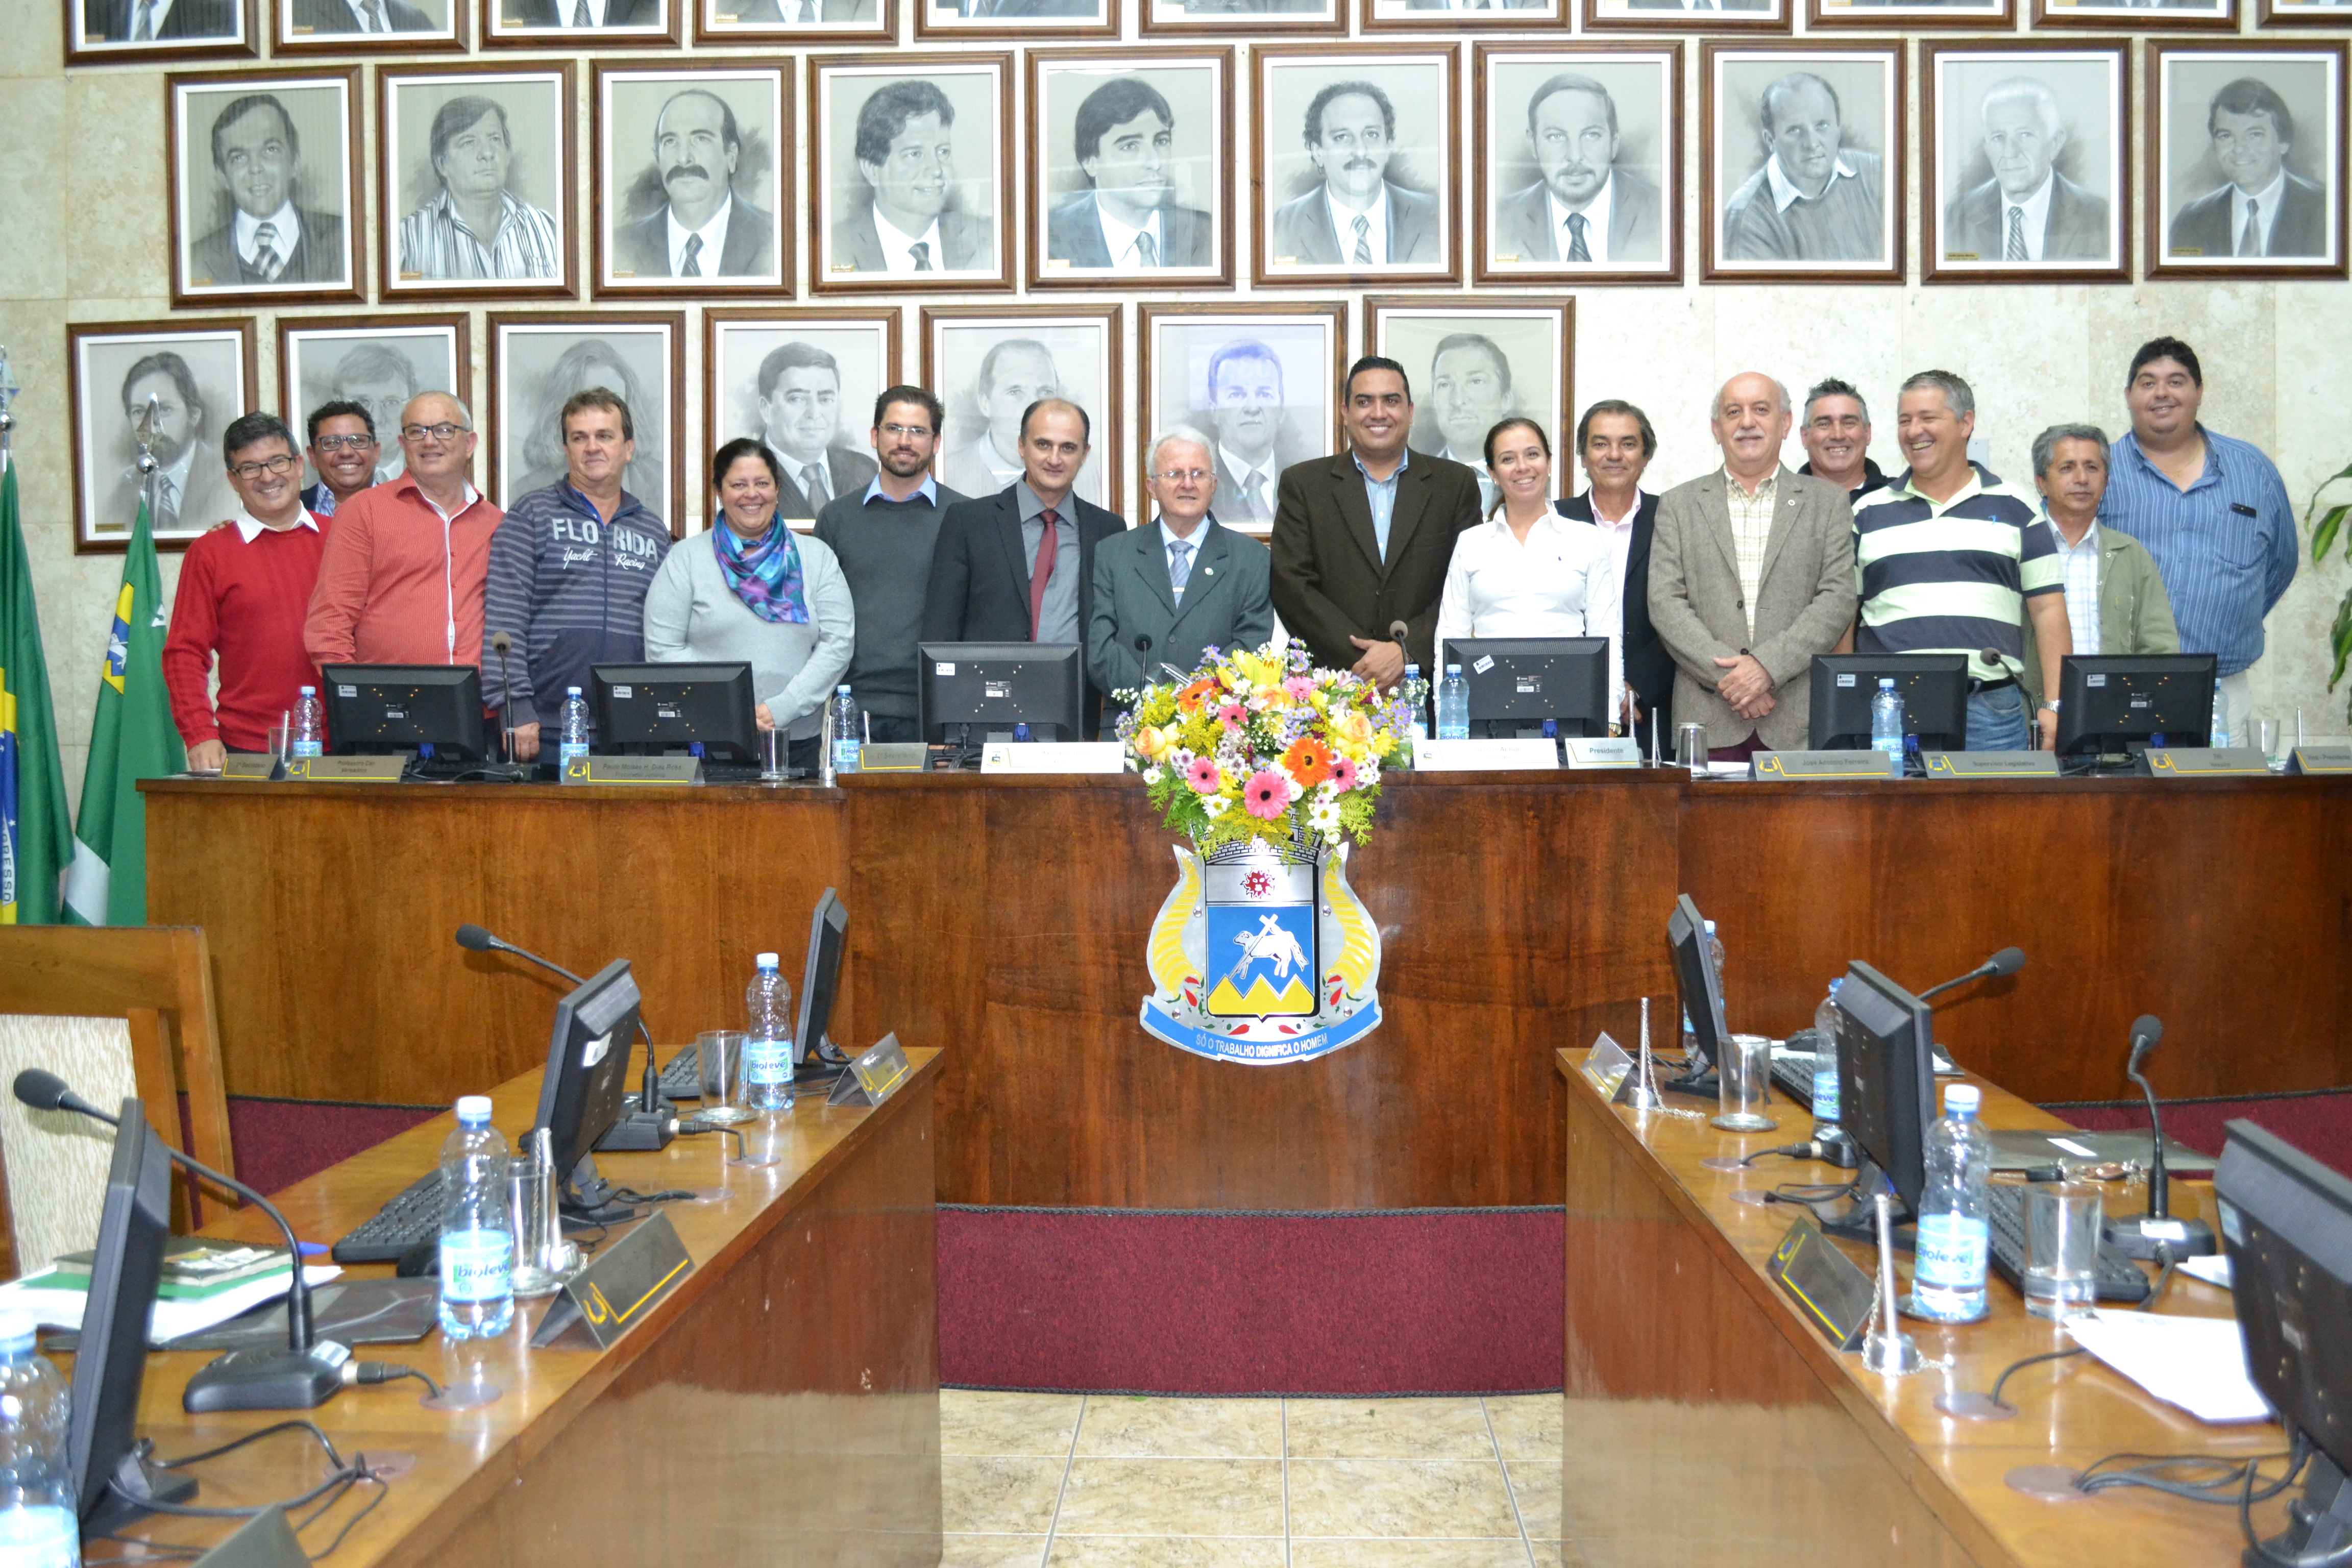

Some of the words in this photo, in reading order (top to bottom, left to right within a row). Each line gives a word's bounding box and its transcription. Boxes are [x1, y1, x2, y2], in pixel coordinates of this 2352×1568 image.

[552, 518, 599, 544] FLO
[614, 525, 658, 562] RIDA
[564, 547, 598, 570] Yacht
[614, 553, 646, 570] Racing
[1196, 1033, 1207, 1047] SÓ
[1208, 1039, 1214, 1049] O
[1215, 1039, 1255, 1057] TRABALHO
[1256, 1043, 1293, 1058] DIGNIFICA
[1293, 1043, 1300, 1055] O
[1301, 1033, 1328, 1051] HOMEM
[752, 1060, 786, 1069] bioleve
[458, 1263, 511, 1277] bioleve
